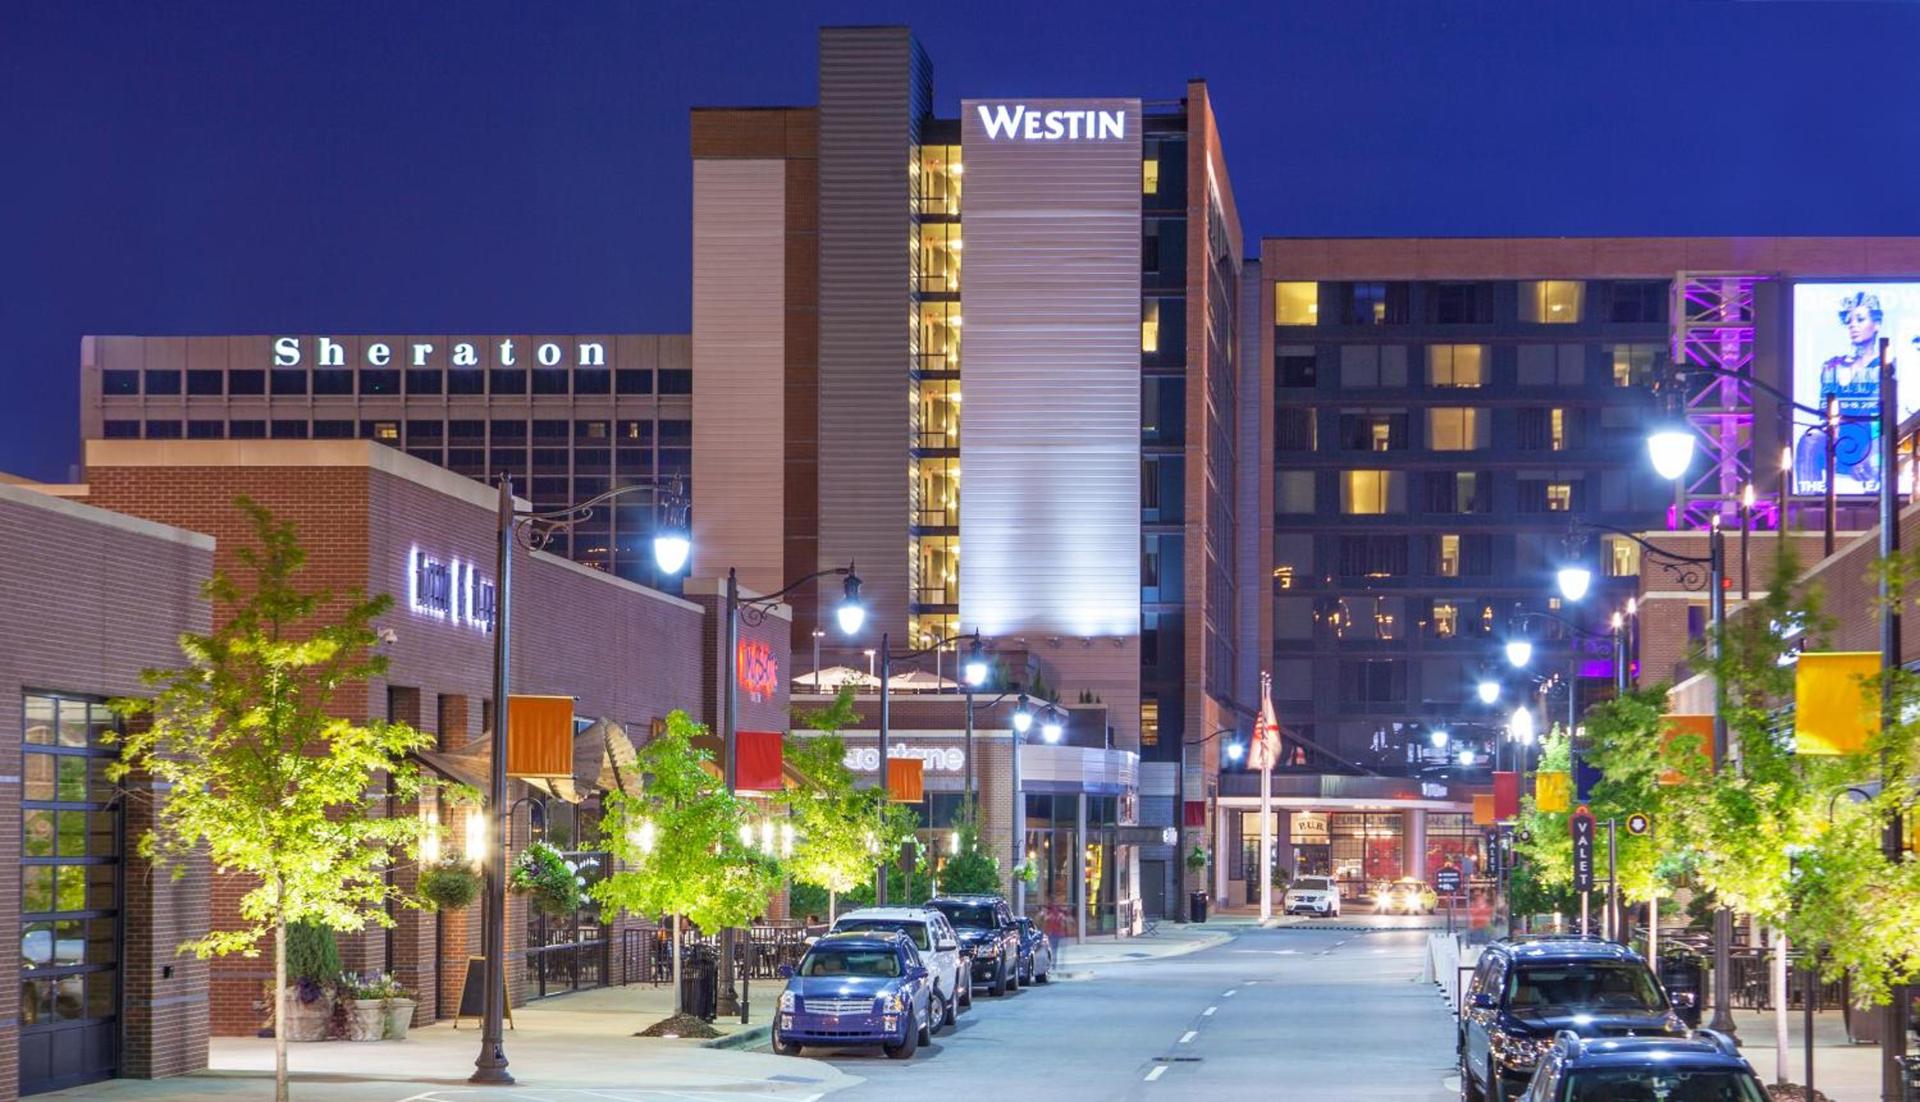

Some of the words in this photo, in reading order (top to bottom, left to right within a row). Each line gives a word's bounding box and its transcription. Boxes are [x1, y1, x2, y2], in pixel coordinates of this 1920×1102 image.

[977, 104, 1126, 140] WESTIN
[273, 336, 606, 366] Sheraton
[1488, 834, 1497, 871] VALET
[1577, 822, 1589, 885] VALET
